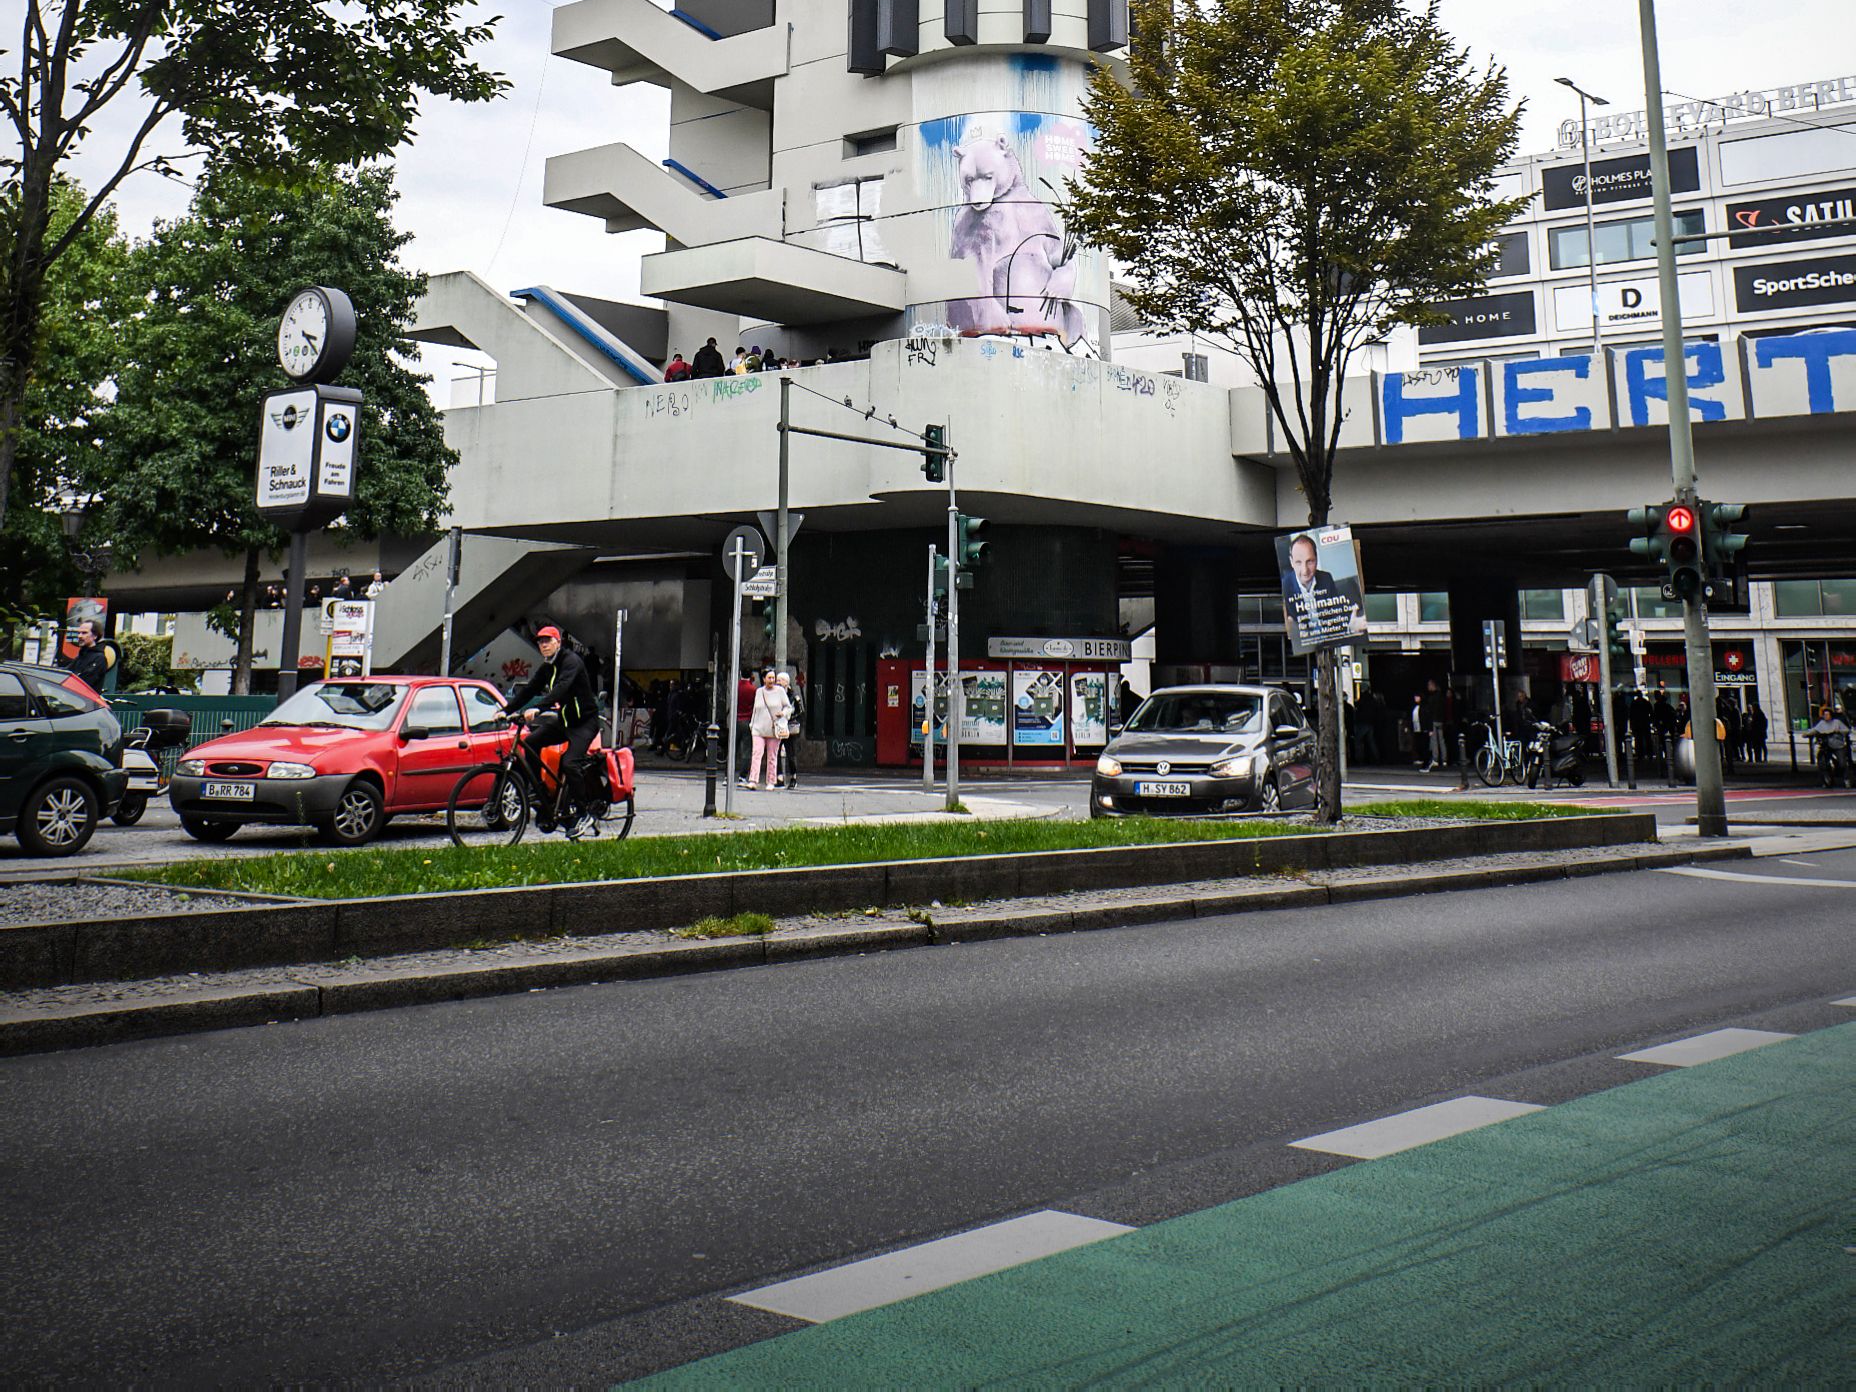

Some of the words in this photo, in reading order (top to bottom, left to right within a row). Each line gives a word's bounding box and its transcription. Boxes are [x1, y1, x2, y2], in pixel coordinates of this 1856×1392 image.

[1596, 93, 1766, 140] BOUEVARD
[1777, 75, 1856, 111] BERL
[1591, 172, 1632, 186] HOLMES
[1634, 169, 1652, 180] PLA
[1753, 271, 1855, 296] SportSche
[1465, 312, 1511, 324] HOME
[1608, 310, 1658, 322] DEICHMANN
[270, 465, 290, 478] Riller
[290, 464, 297, 476] &
[326, 462, 346, 470] Freude
[269, 477, 307, 492] Schnauck
[324, 478, 345, 487] Fahren
[1321, 535, 1340, 545] CDU
[1295, 595, 1350, 613] Heilmann,
[1084, 641, 1129, 656] BIERPIN
[1714, 671, 1756, 682] EINGANG
[208, 784, 215, 795] B
[220, 785, 232, 796] RR
[234, 785, 250, 796] 784
[1143, 783, 1150, 793] H
[1155, 784, 1167, 794] SY
[1169, 784, 1187, 795] 862
